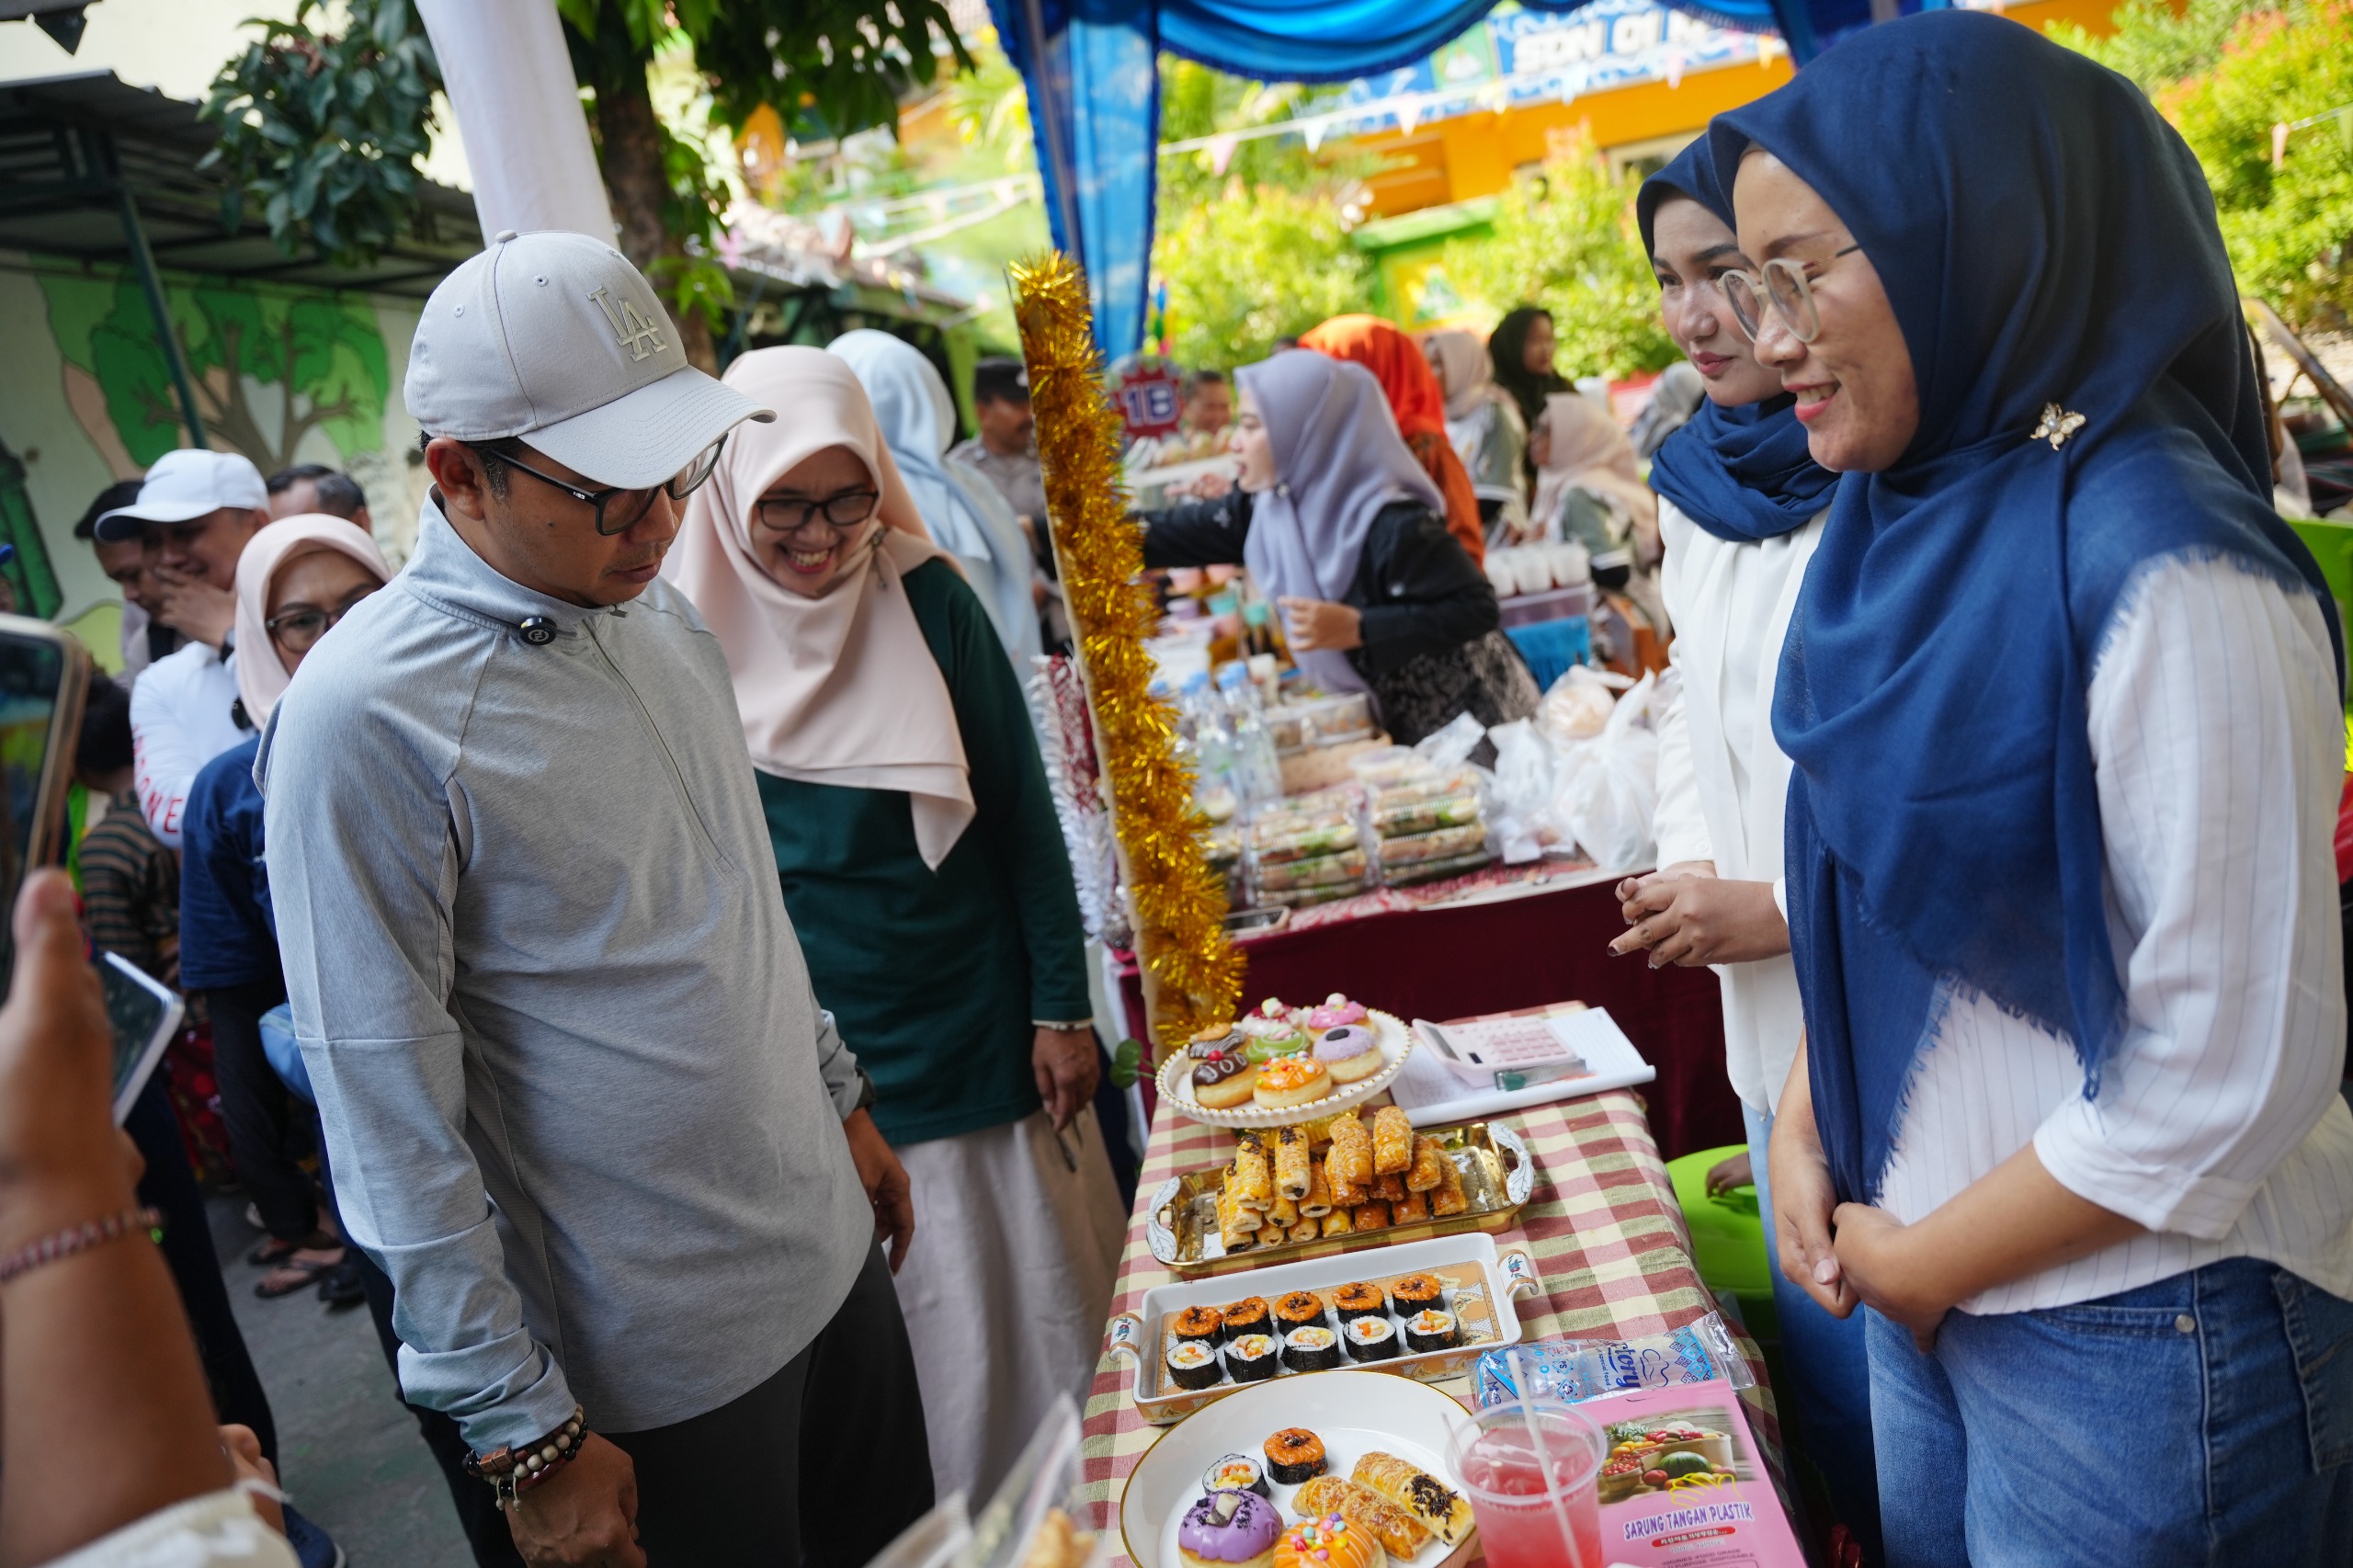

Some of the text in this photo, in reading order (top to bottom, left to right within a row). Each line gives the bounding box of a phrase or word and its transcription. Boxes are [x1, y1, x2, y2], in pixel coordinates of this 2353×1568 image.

[585, 285, 667, 362] LA
[1597, 1353, 1612, 1386] special food
[1624, 1515, 1665, 1540] SARUNG
[1666, 1507, 1708, 1529] TANGAN
[1709, 1503, 1753, 1522] PLASTIK
